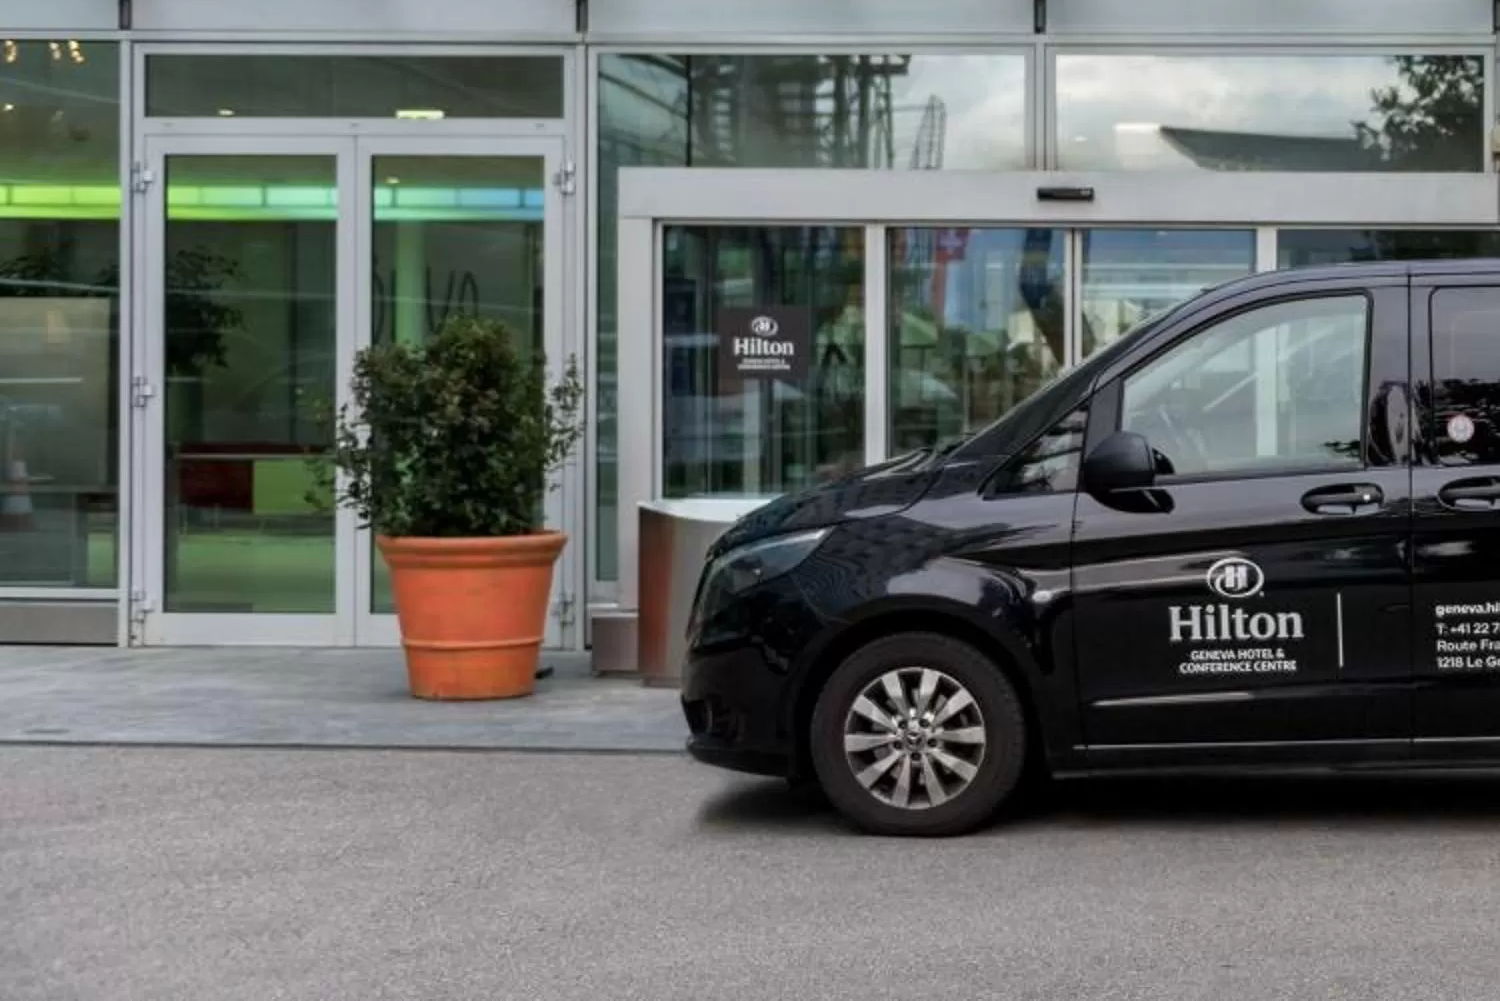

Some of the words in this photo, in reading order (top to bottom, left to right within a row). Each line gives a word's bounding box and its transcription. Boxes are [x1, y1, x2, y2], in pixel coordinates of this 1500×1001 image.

[733, 336, 794, 356] Hilton
[1168, 603, 1304, 641] Hilton
[1473, 622, 1490, 634] 22
[1437, 639, 1478, 651] Route
[1190, 649, 1236, 661] GENEVA
[1238, 649, 1274, 660] HOTEL
[1275, 648, 1285, 659] &
[1179, 661, 1252, 674] CONFERENCE
[1253, 660, 1297, 672] CENTRE
[1437, 656, 1464, 668] 1218
[1466, 656, 1483, 668] Le
